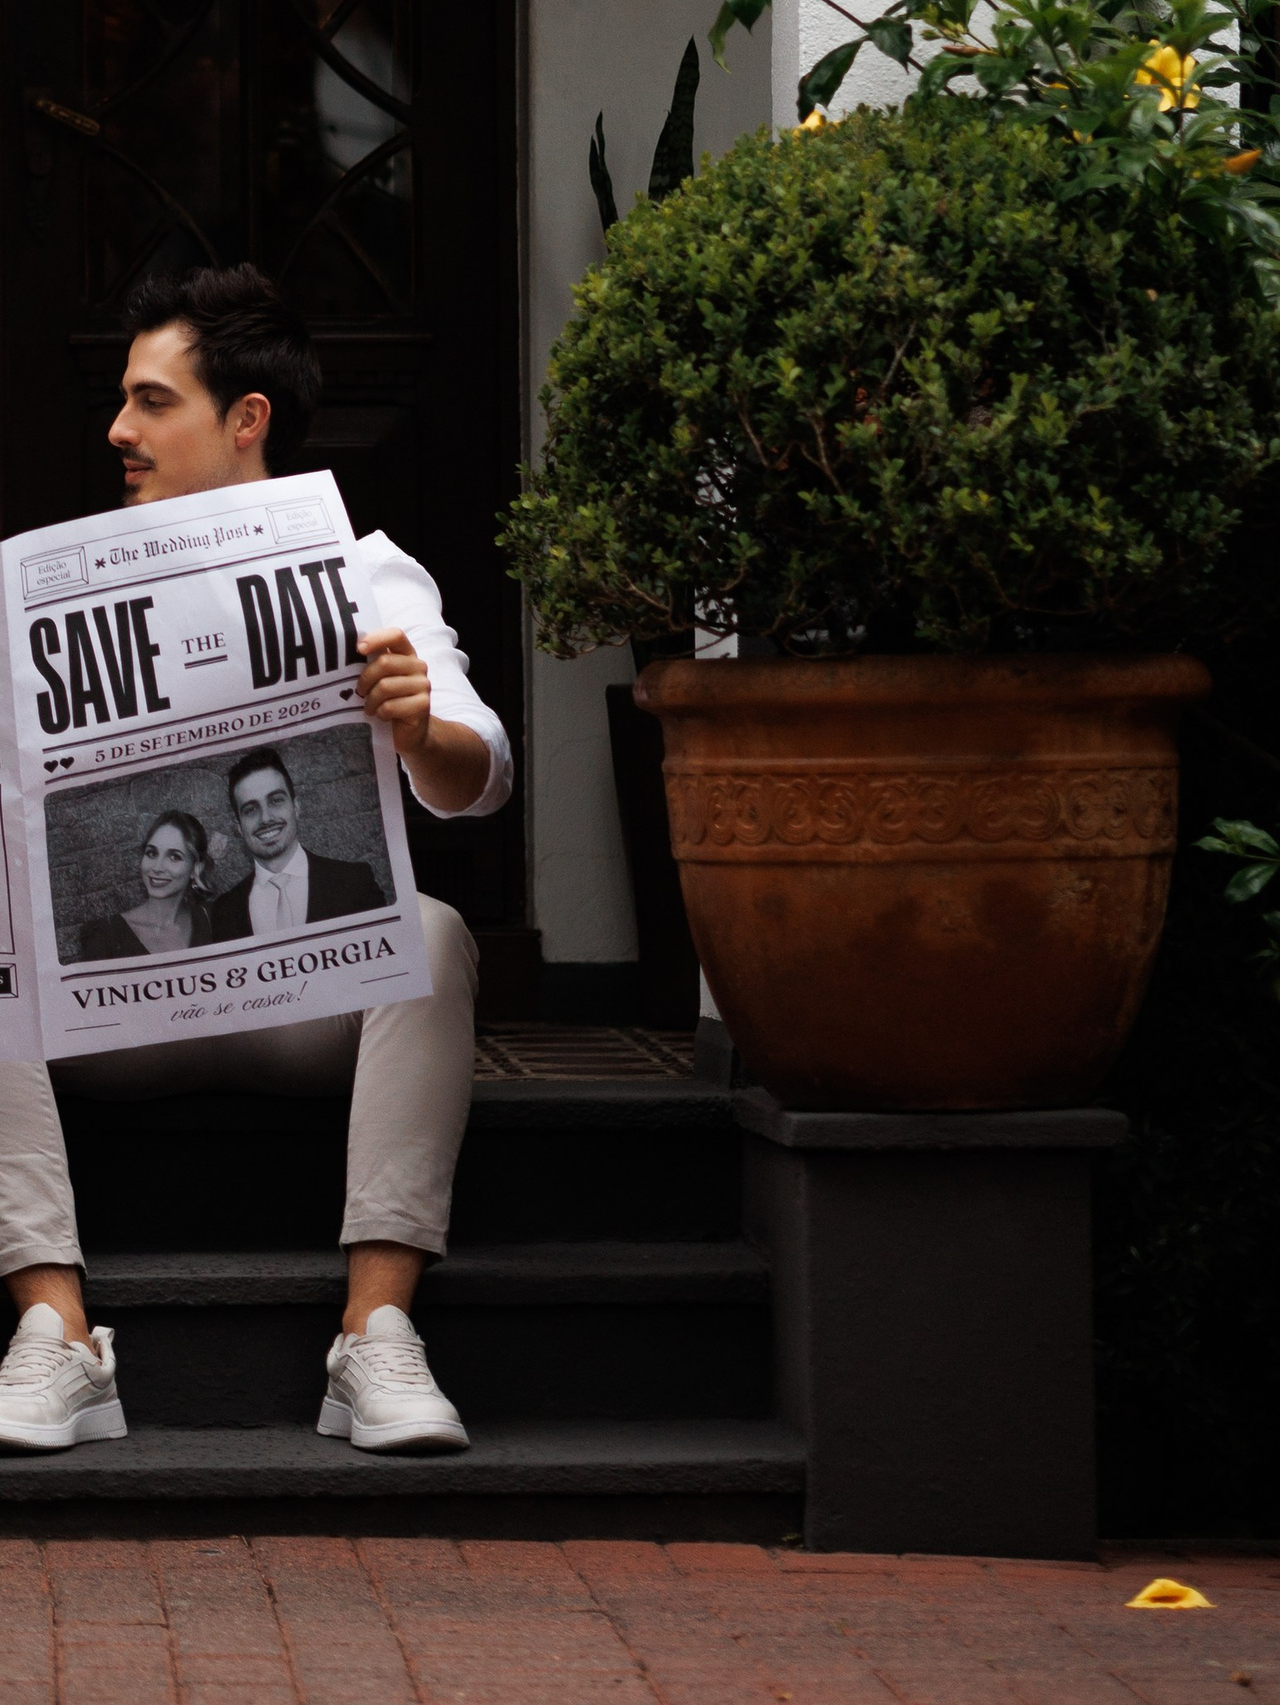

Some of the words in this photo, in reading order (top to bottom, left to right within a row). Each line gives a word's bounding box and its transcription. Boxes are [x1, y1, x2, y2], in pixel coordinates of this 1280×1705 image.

[109, 547, 139, 566] The
[143, 533, 210, 559] Wedding
[213, 522, 250, 547] Post
[36, 570, 71, 586] especial
[38, 560, 67, 575] Edição
[29, 596, 171, 735] SAVE
[181, 632, 227, 654] THE
[236, 556, 369, 690] DATE
[95, 749, 108, 763] 5
[110, 741, 136, 760] DE
[140, 718, 245, 754] SETEMBRO
[248, 711, 274, 728] DE
[278, 698, 321, 721] 2026
[71, 971, 218, 1010] VINICIUS
[225, 967, 250, 990] &
[256, 936, 397, 982] GEORGIA
[170, 1004, 207, 1023] vão
[214, 1001, 234, 1017] se
[242, 981, 308, 1013] casar!
